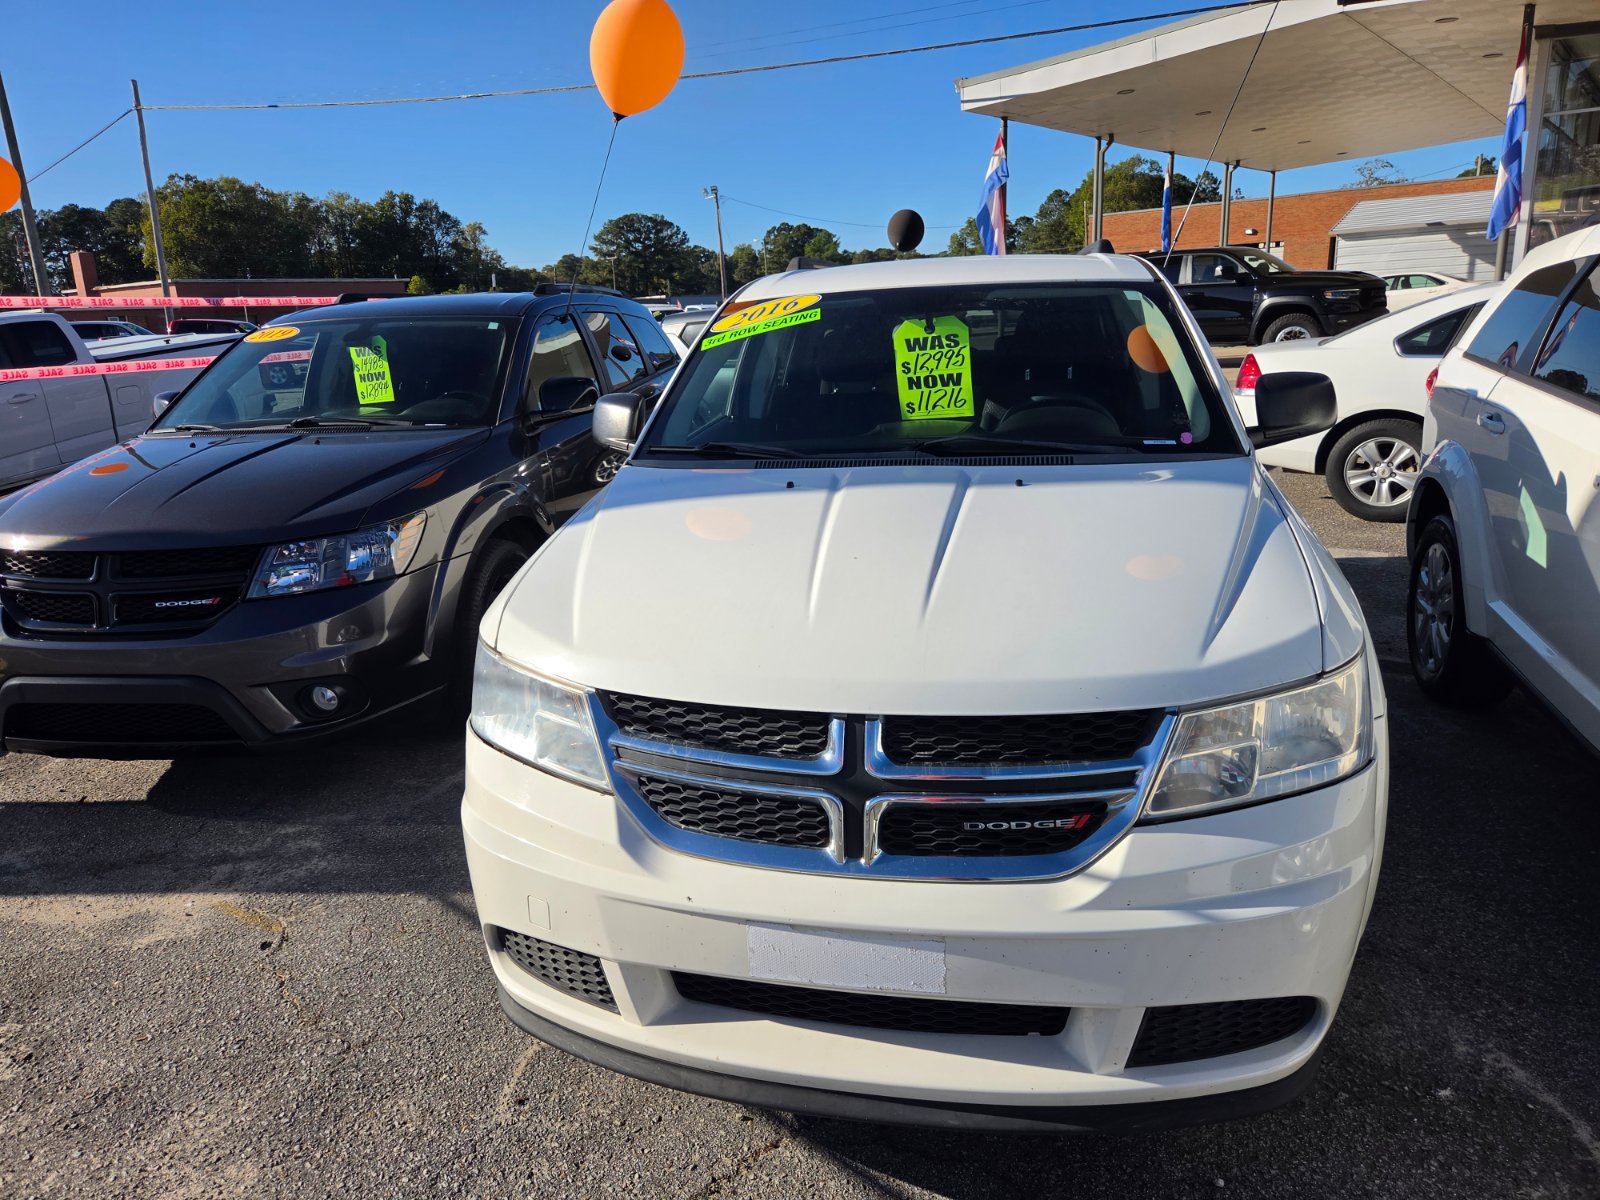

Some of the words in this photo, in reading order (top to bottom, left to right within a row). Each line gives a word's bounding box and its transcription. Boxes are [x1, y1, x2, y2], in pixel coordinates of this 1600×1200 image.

[728, 297, 800, 328] 2016
[704, 335, 726, 347] 3rd
[729, 325, 760, 339] ROW
[762, 311, 818, 330] SEATING
[904, 334, 960, 352] WAS
[359, 371, 385, 382] NOW
[907, 372, 962, 390] NOW
[155, 599, 212, 607] DODGE
[964, 818, 1075, 830] DODGE
